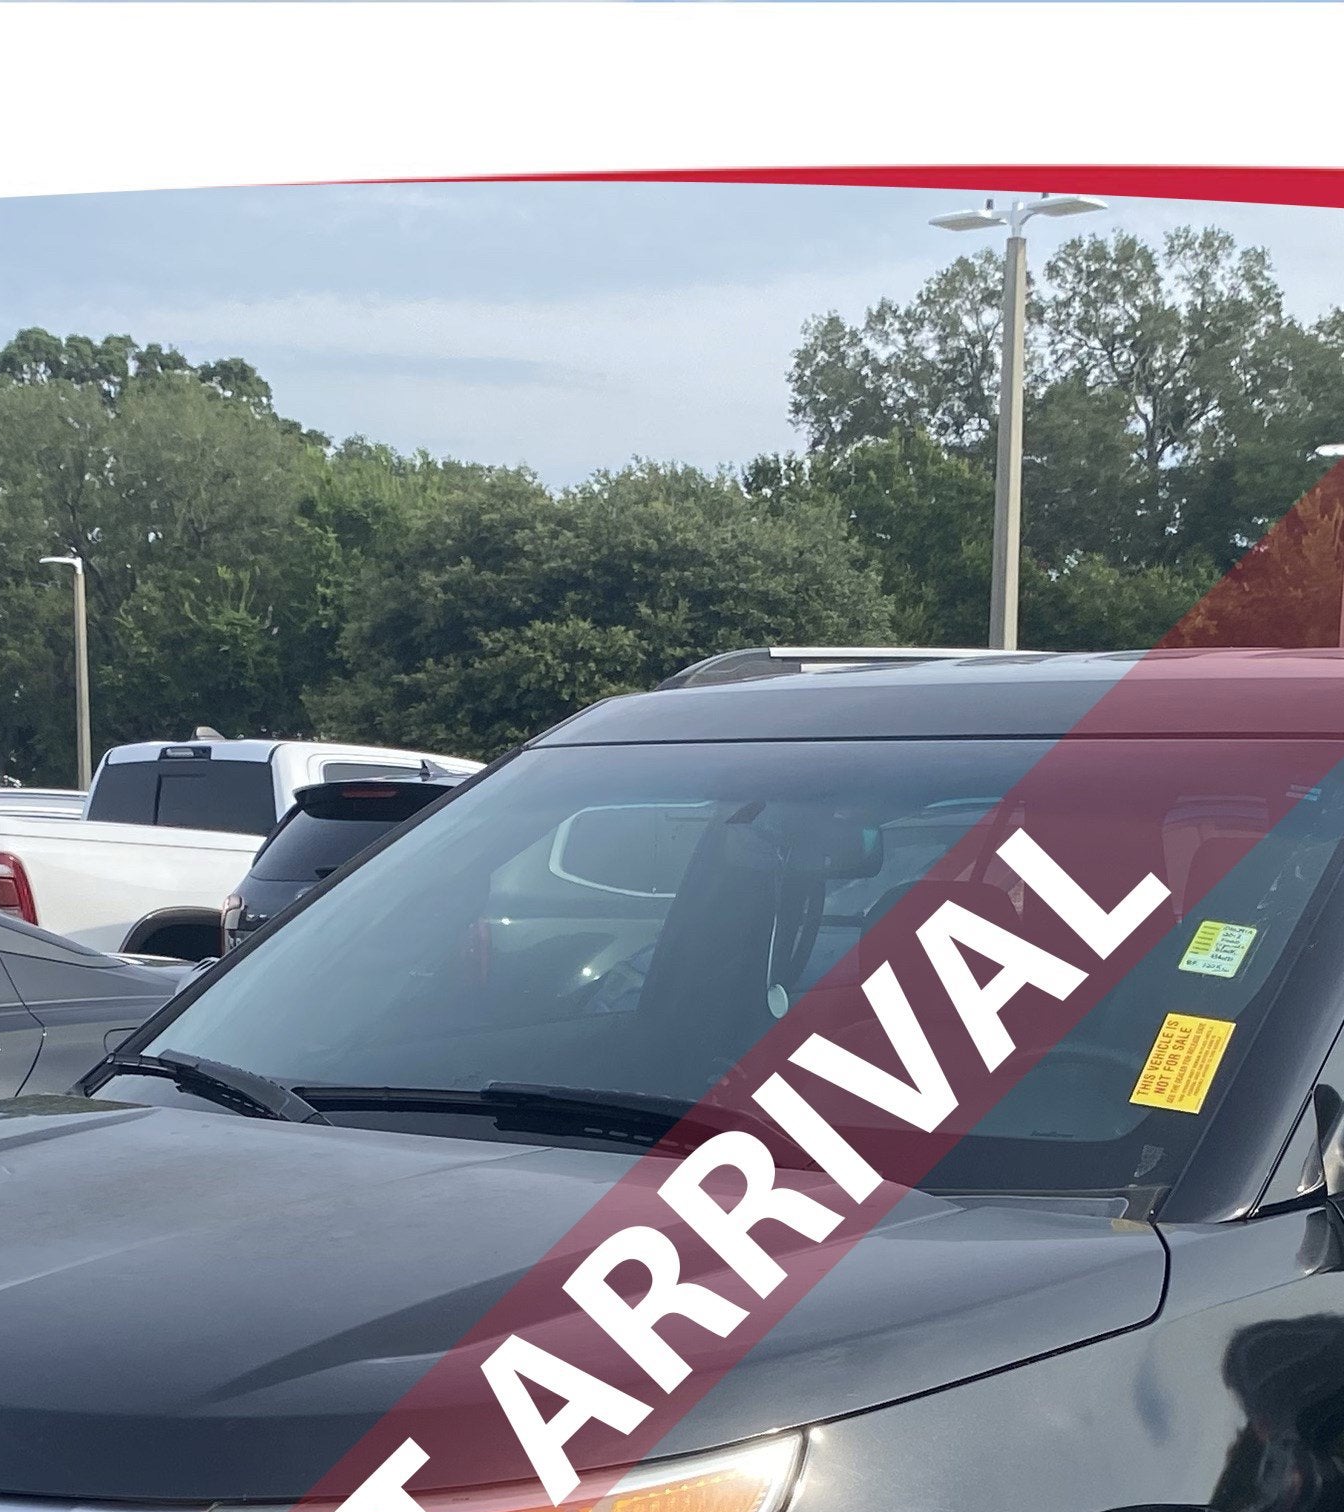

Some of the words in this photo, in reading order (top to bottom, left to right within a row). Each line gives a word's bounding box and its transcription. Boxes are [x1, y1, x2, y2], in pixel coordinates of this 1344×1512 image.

[1172, 1027, 1192, 1051] SALE
[1137, 1074, 1155, 1095] THIS
[1148, 1033, 1174, 1070] VEHICLE
[1167, 1020, 1179, 1030] IS
[1164, 1054, 1181, 1072] FOR
[1155, 1076, 1170, 1094] NOT
